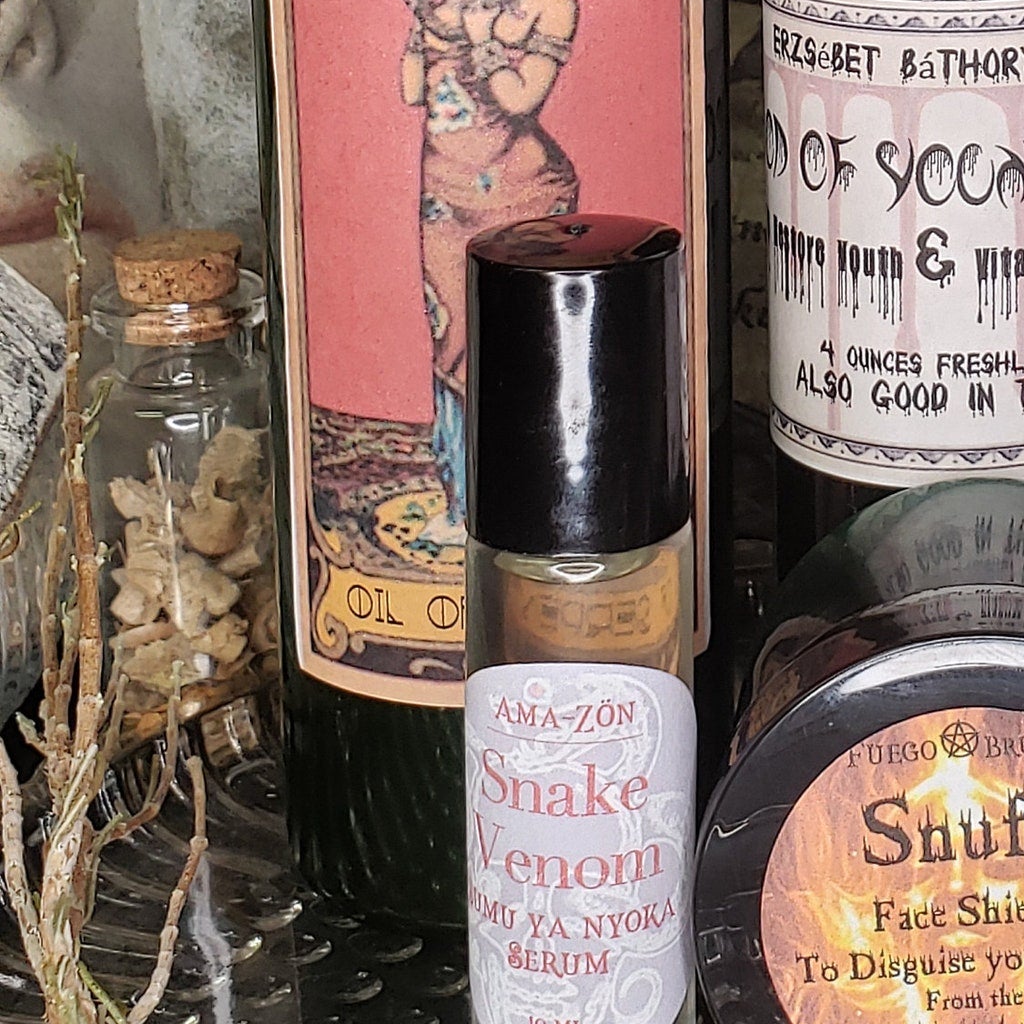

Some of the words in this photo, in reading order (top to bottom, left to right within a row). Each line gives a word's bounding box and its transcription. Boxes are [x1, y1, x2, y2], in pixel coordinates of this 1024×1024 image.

[799, 128, 858, 200] OF
[915, 226, 956, 289] &
[820, 339, 835, 366] 4
[846, 344, 923, 378] OUNCES
[796, 359, 853, 407] ALSO
[870, 378, 949, 416] GOOD
[968, 381, 995, 416] IN
[346, 584, 404, 626] OIL
[494, 696, 637, 734] AMA-ZÖN
[846, 739, 937, 768] FUEGO
[480, 748, 649, 818] Snake
[472, 810, 664, 890] Venom
[527, 912, 571, 940] YA
[583, 896, 676, 940] NYOKA
[873, 895, 948, 933] Face
[507, 941, 612, 979] SERUM
[794, 948, 839, 985] To
[849, 944, 976, 986] Disguise
[925, 987, 984, 1012] From
[991, 982, 1024, 1007] the
